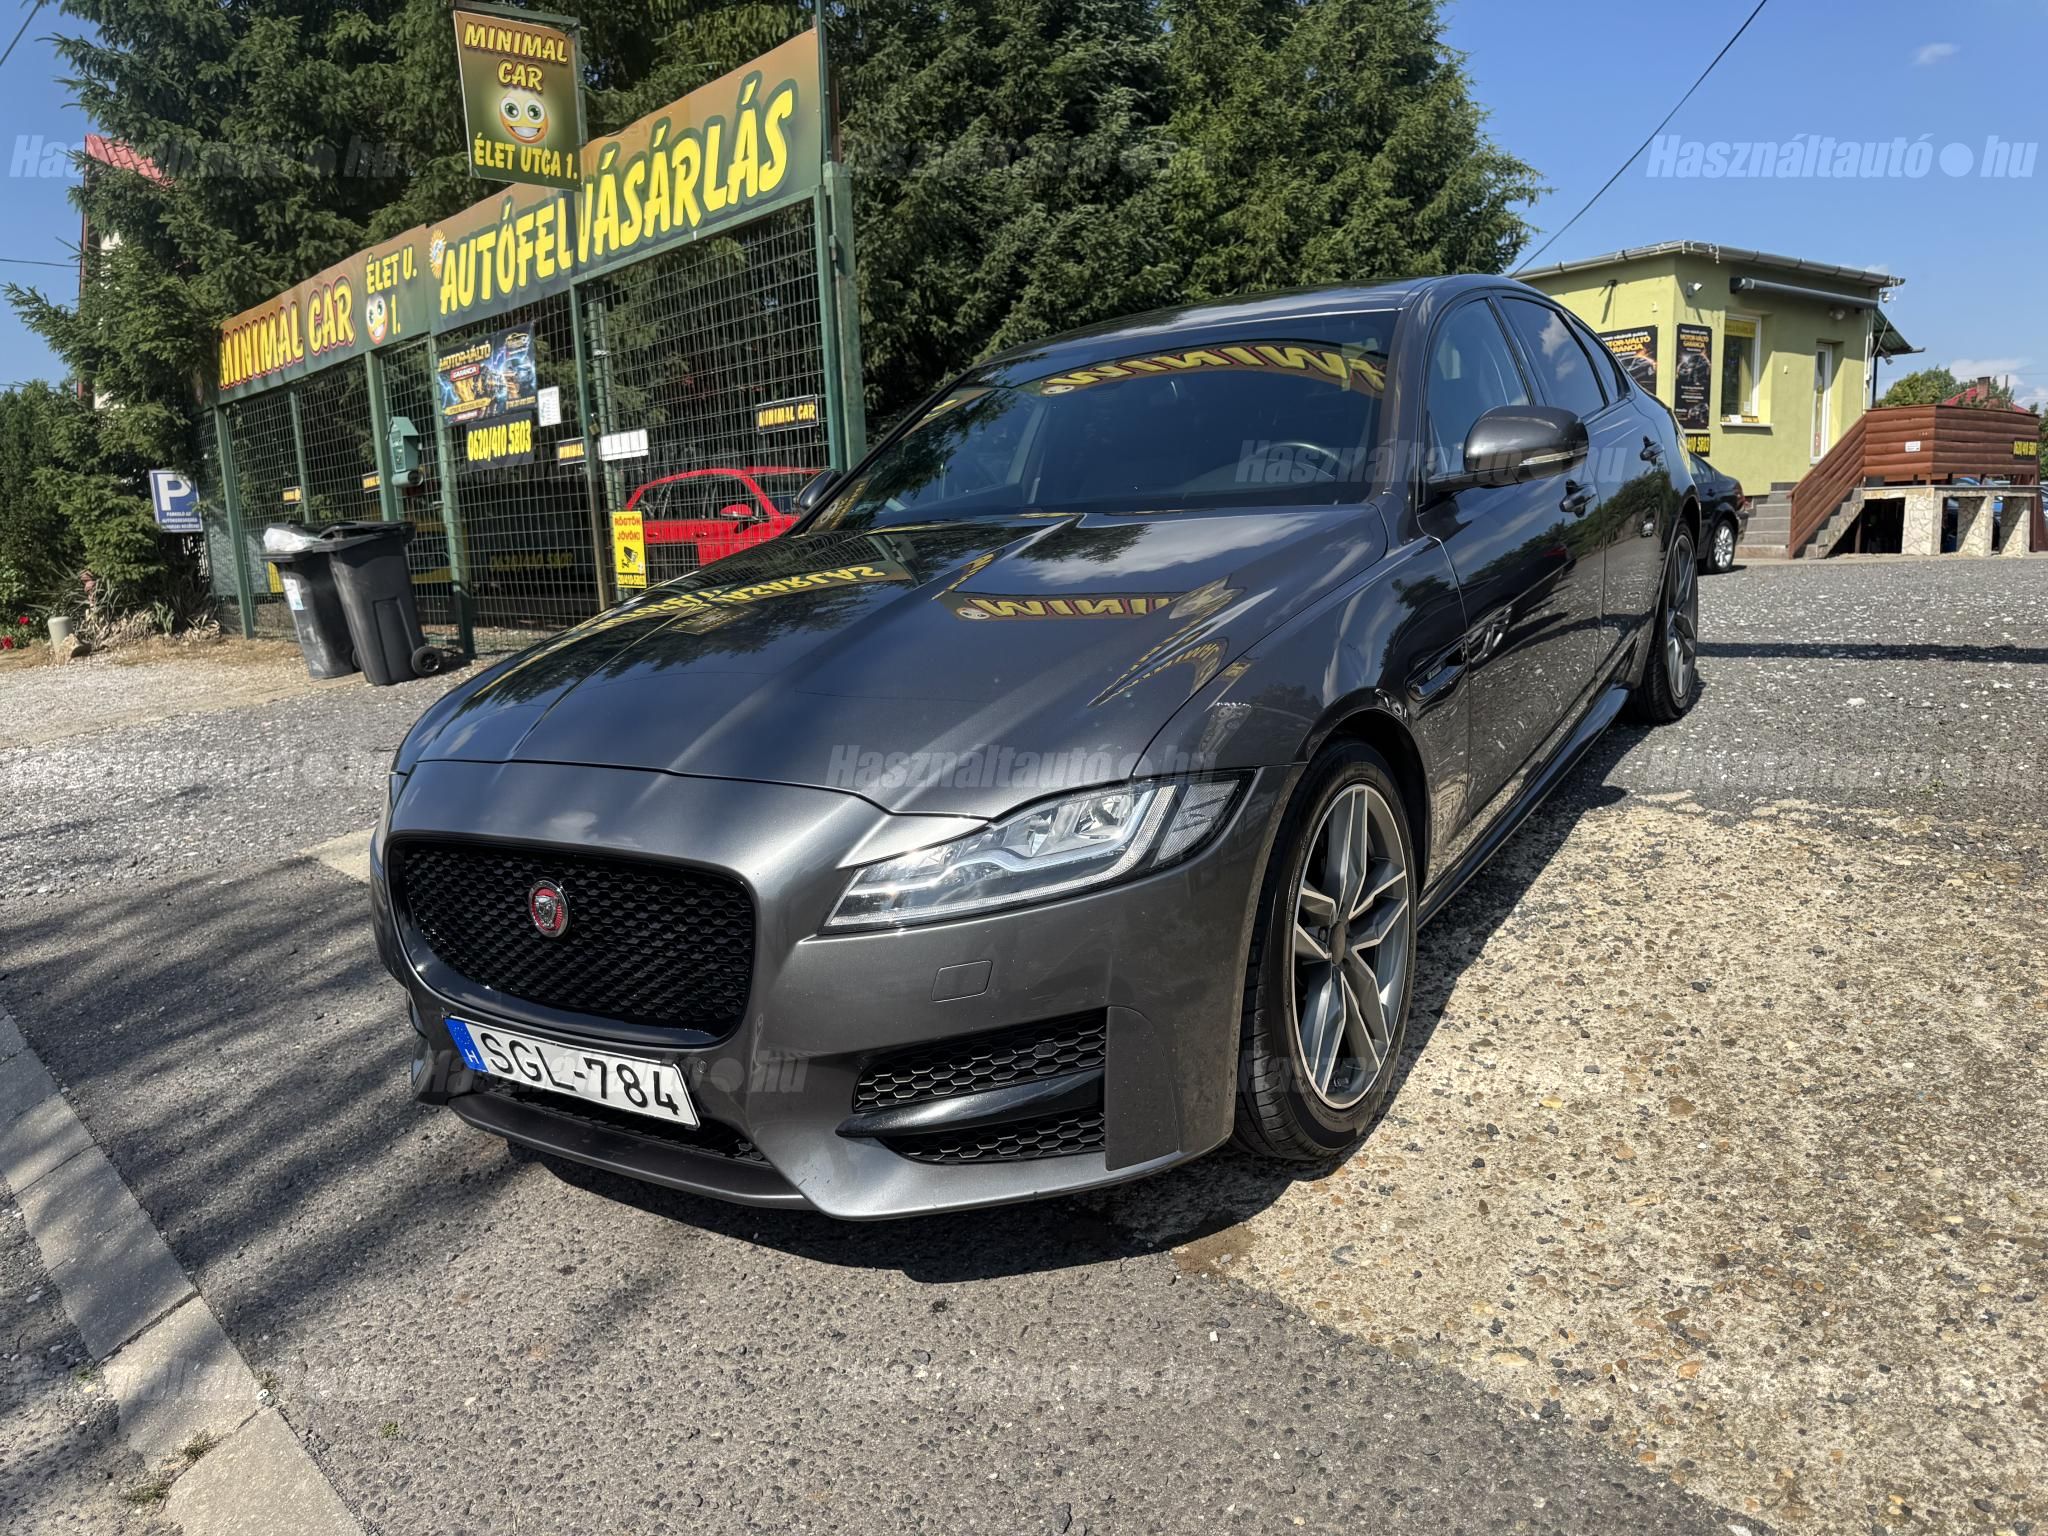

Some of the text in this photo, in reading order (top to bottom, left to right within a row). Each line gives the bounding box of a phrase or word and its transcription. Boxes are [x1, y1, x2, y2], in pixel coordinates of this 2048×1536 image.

[464, 22, 568, 63] MINIMAL
[498, 60, 544, 91] CAR
[474, 132, 578, 180] ÉLET UTCA 1.
[439, 78, 793, 316] AUTÓFELVÁSÁRLÁS
[365, 246, 418, 295] ÉLET U.
[219, 281, 355, 388] MINIMAL CAR
[390, 294, 401, 335] 1.
[797, 402, 816, 420] CAR
[467, 424, 507, 461] 0620/410
[508, 420, 532, 455] 5803
[157, 473, 192, 511] P
[466, 1051, 480, 1065] H
[480, 1031, 680, 1117] SGL-784
